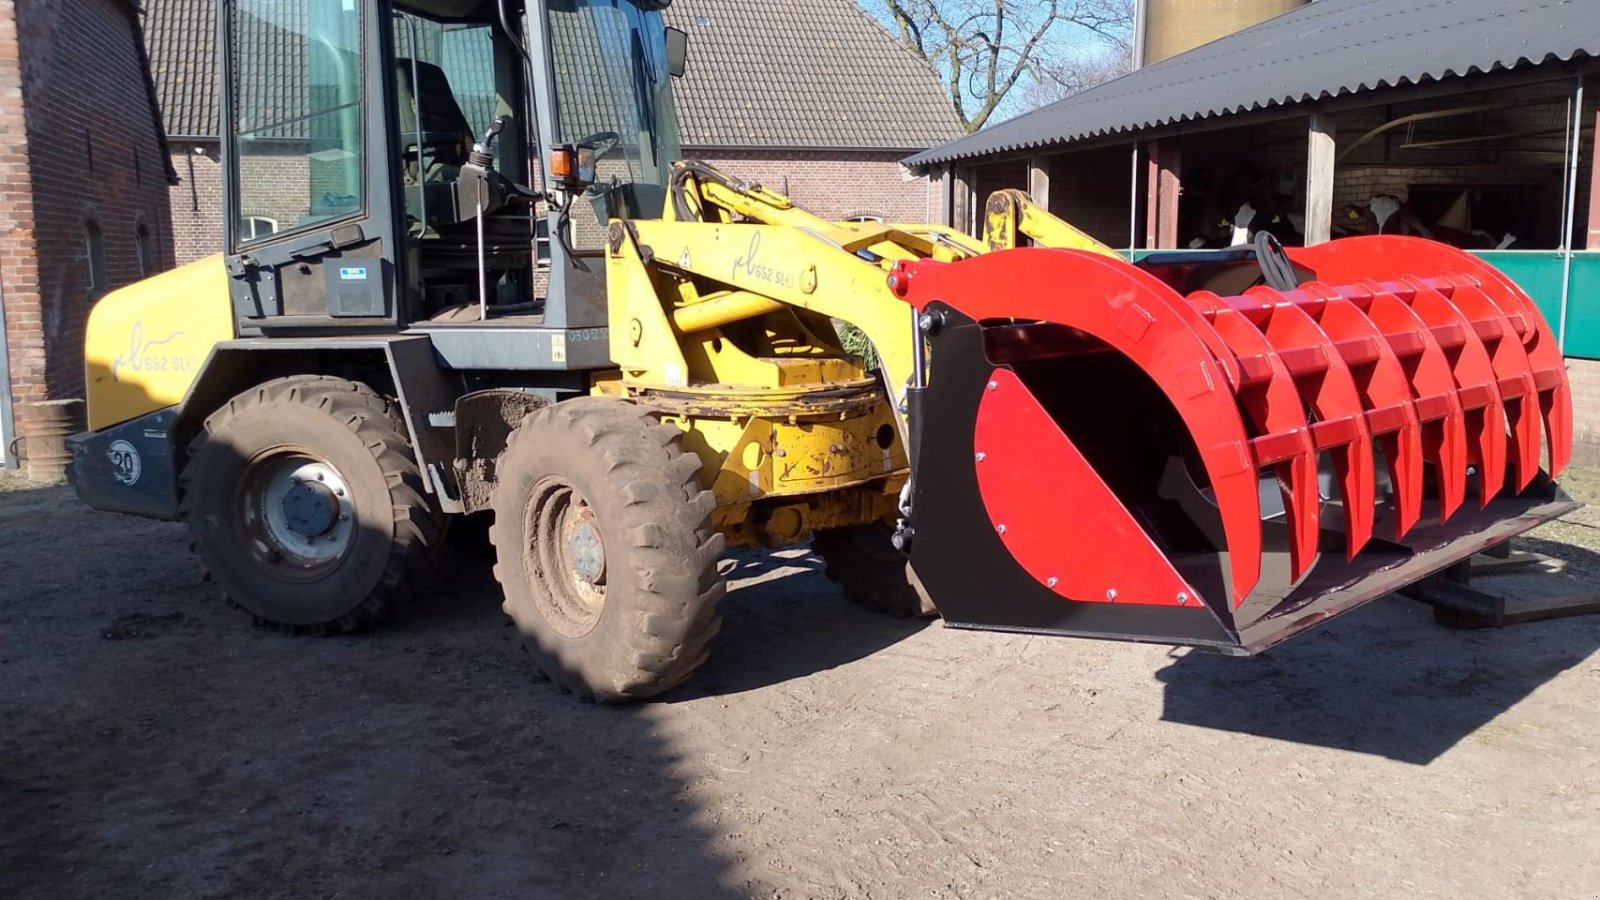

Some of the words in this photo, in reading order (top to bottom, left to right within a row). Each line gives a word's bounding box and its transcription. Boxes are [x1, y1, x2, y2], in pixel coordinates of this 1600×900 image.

[755, 264, 773, 281] 652
[145, 357, 168, 371] 652
[112, 452, 133, 474] 20
